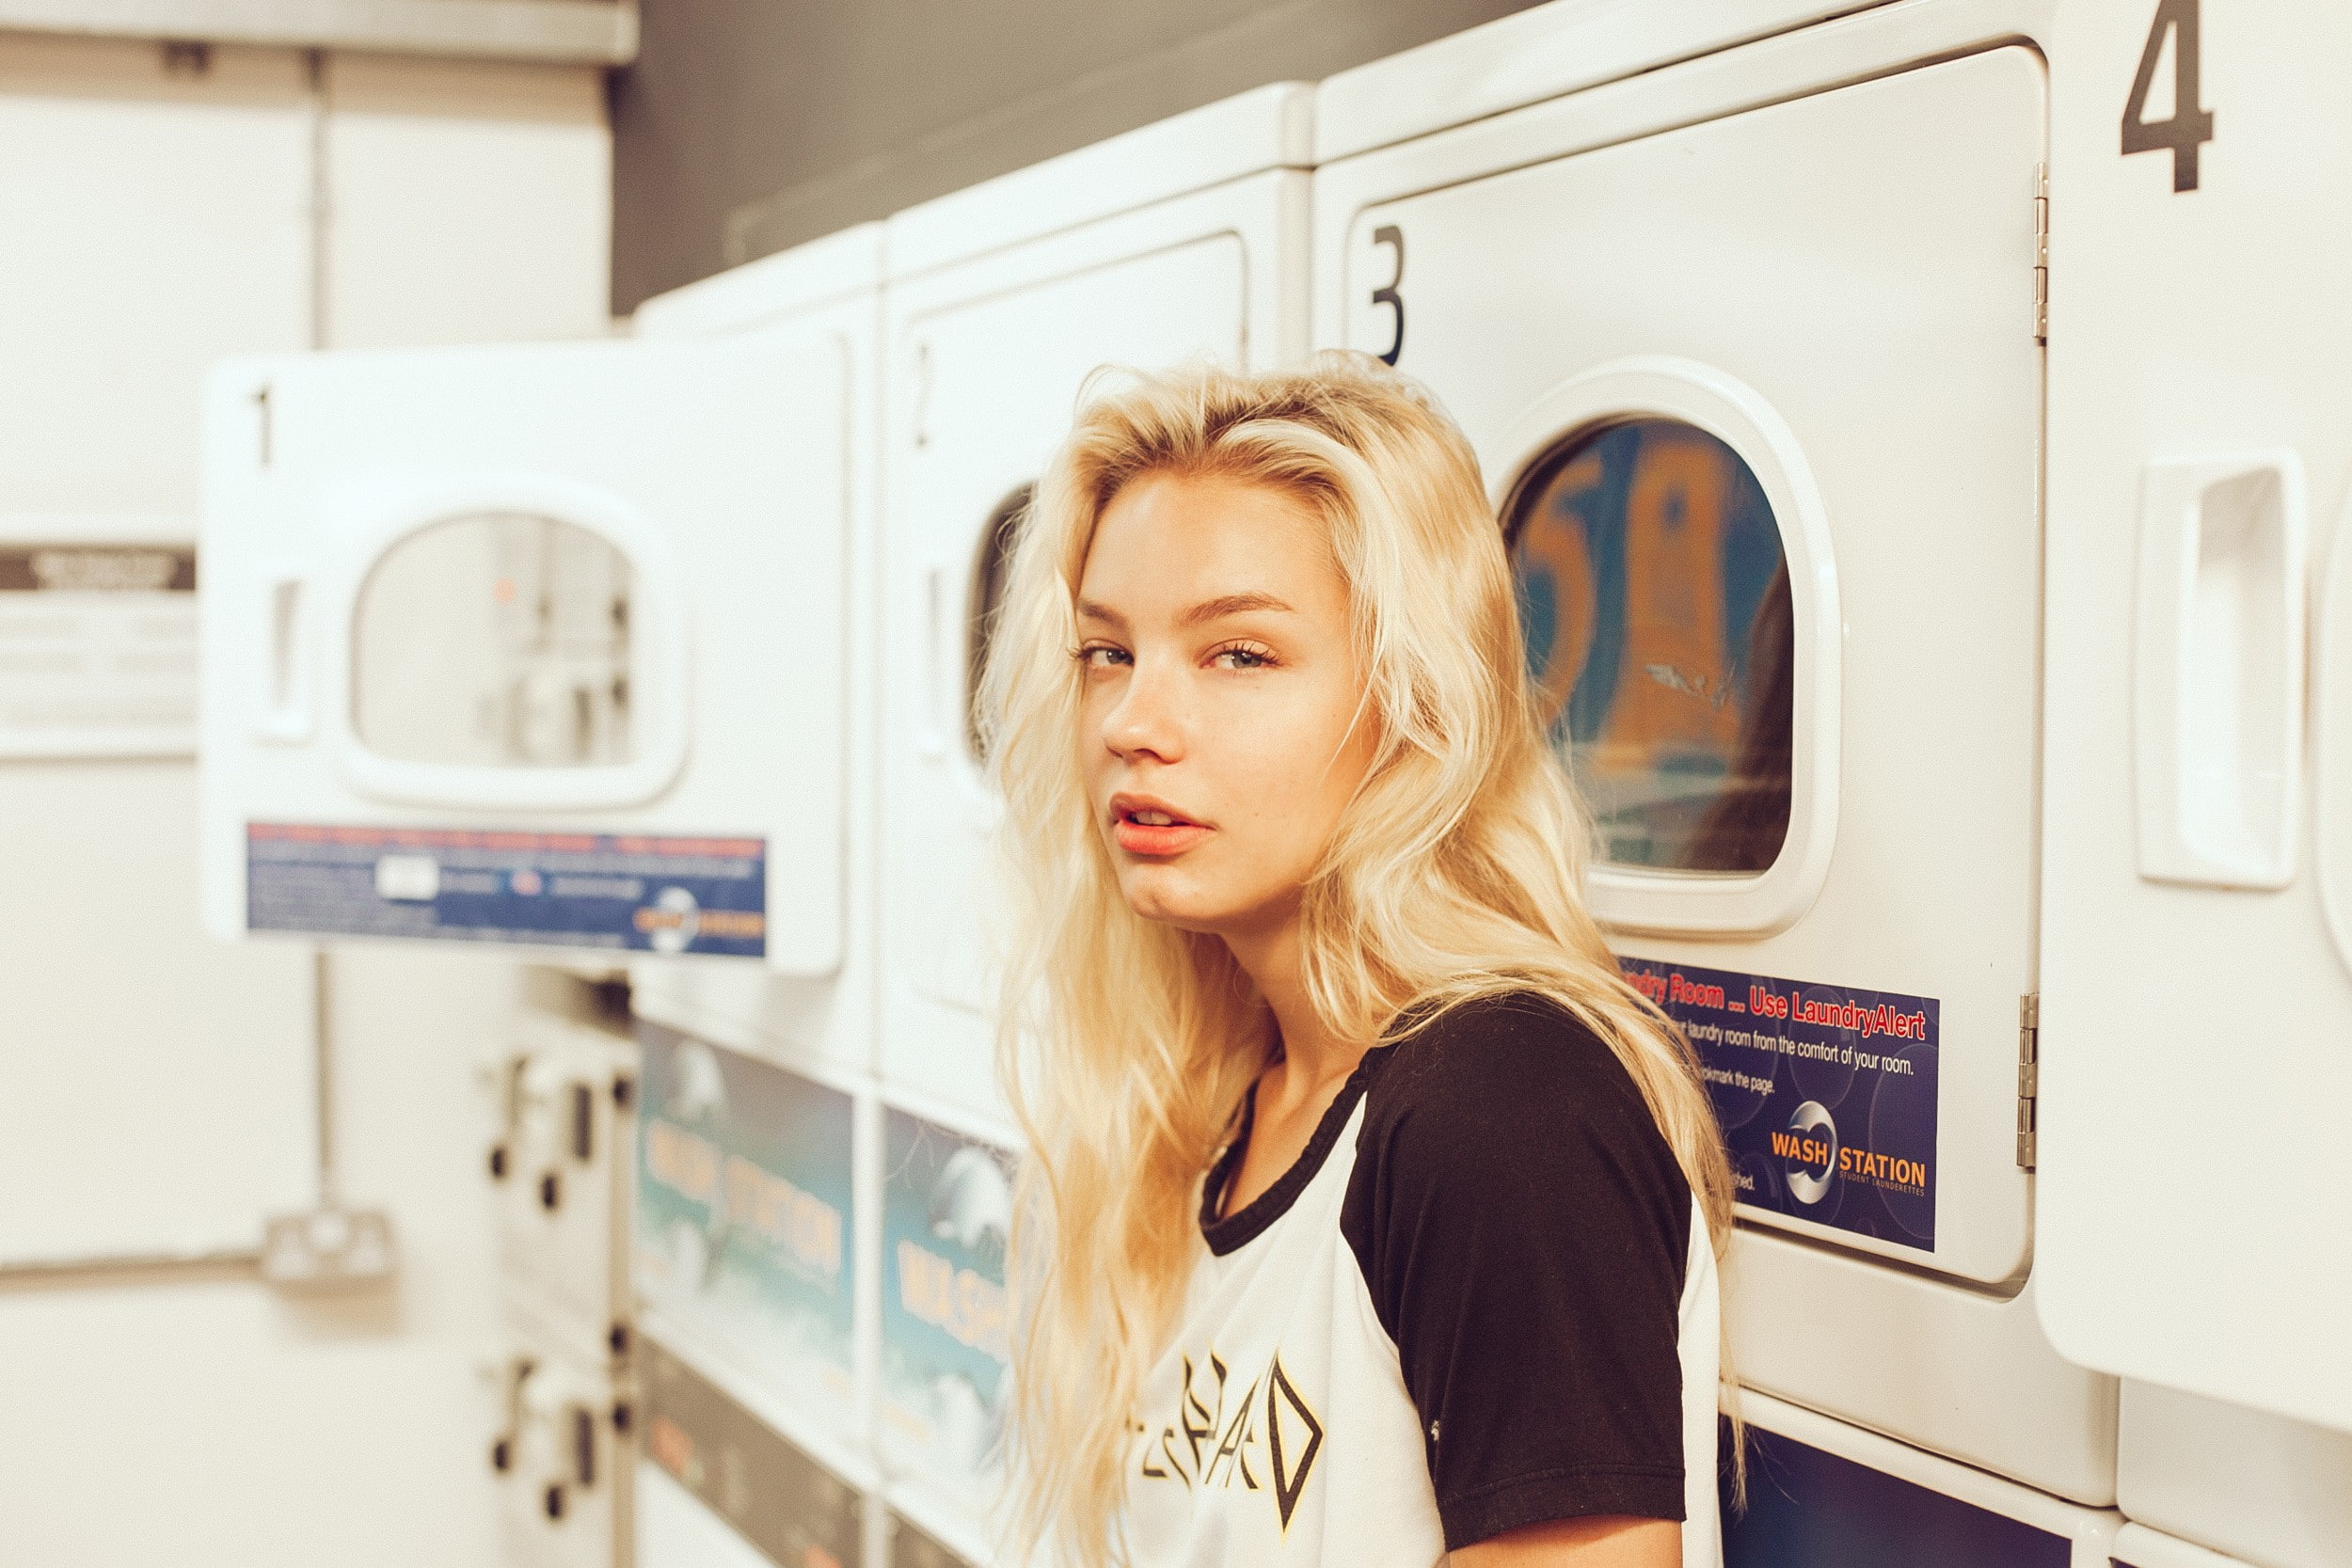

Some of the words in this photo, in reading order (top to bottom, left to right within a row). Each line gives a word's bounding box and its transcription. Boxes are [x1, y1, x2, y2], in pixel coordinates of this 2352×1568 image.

[2122, 0, 2214, 194] 4
[1373, 225, 1404, 368] 3
[248, 384, 272, 468] 1
[1670, 973, 1724, 1009] Room
[1750, 985, 1788, 1020] Use
[1792, 991, 1926, 1040] LaundryAlert
[1688, 1020, 1724, 1046] laundry
[1725, 1029, 1751, 1046] room
[1753, 1030, 1777, 1052] from
[1778, 1036, 1795, 1055] the
[1798, 1041, 1839, 1064] comfort
[1841, 1046, 1853, 1065] of
[1854, 1052, 1879, 1070] your
[1882, 1056, 1915, 1075] room.
[1735, 1070, 1749, 1088] the
[1751, 1076, 1775, 1096] page.
[1772, 1132, 1829, 1165] WASH
[1839, 1147, 1926, 1187] STATION
[1839, 1170, 1870, 1184] STUDENT
[1871, 1179, 1925, 1197] LAUNDERETTES
